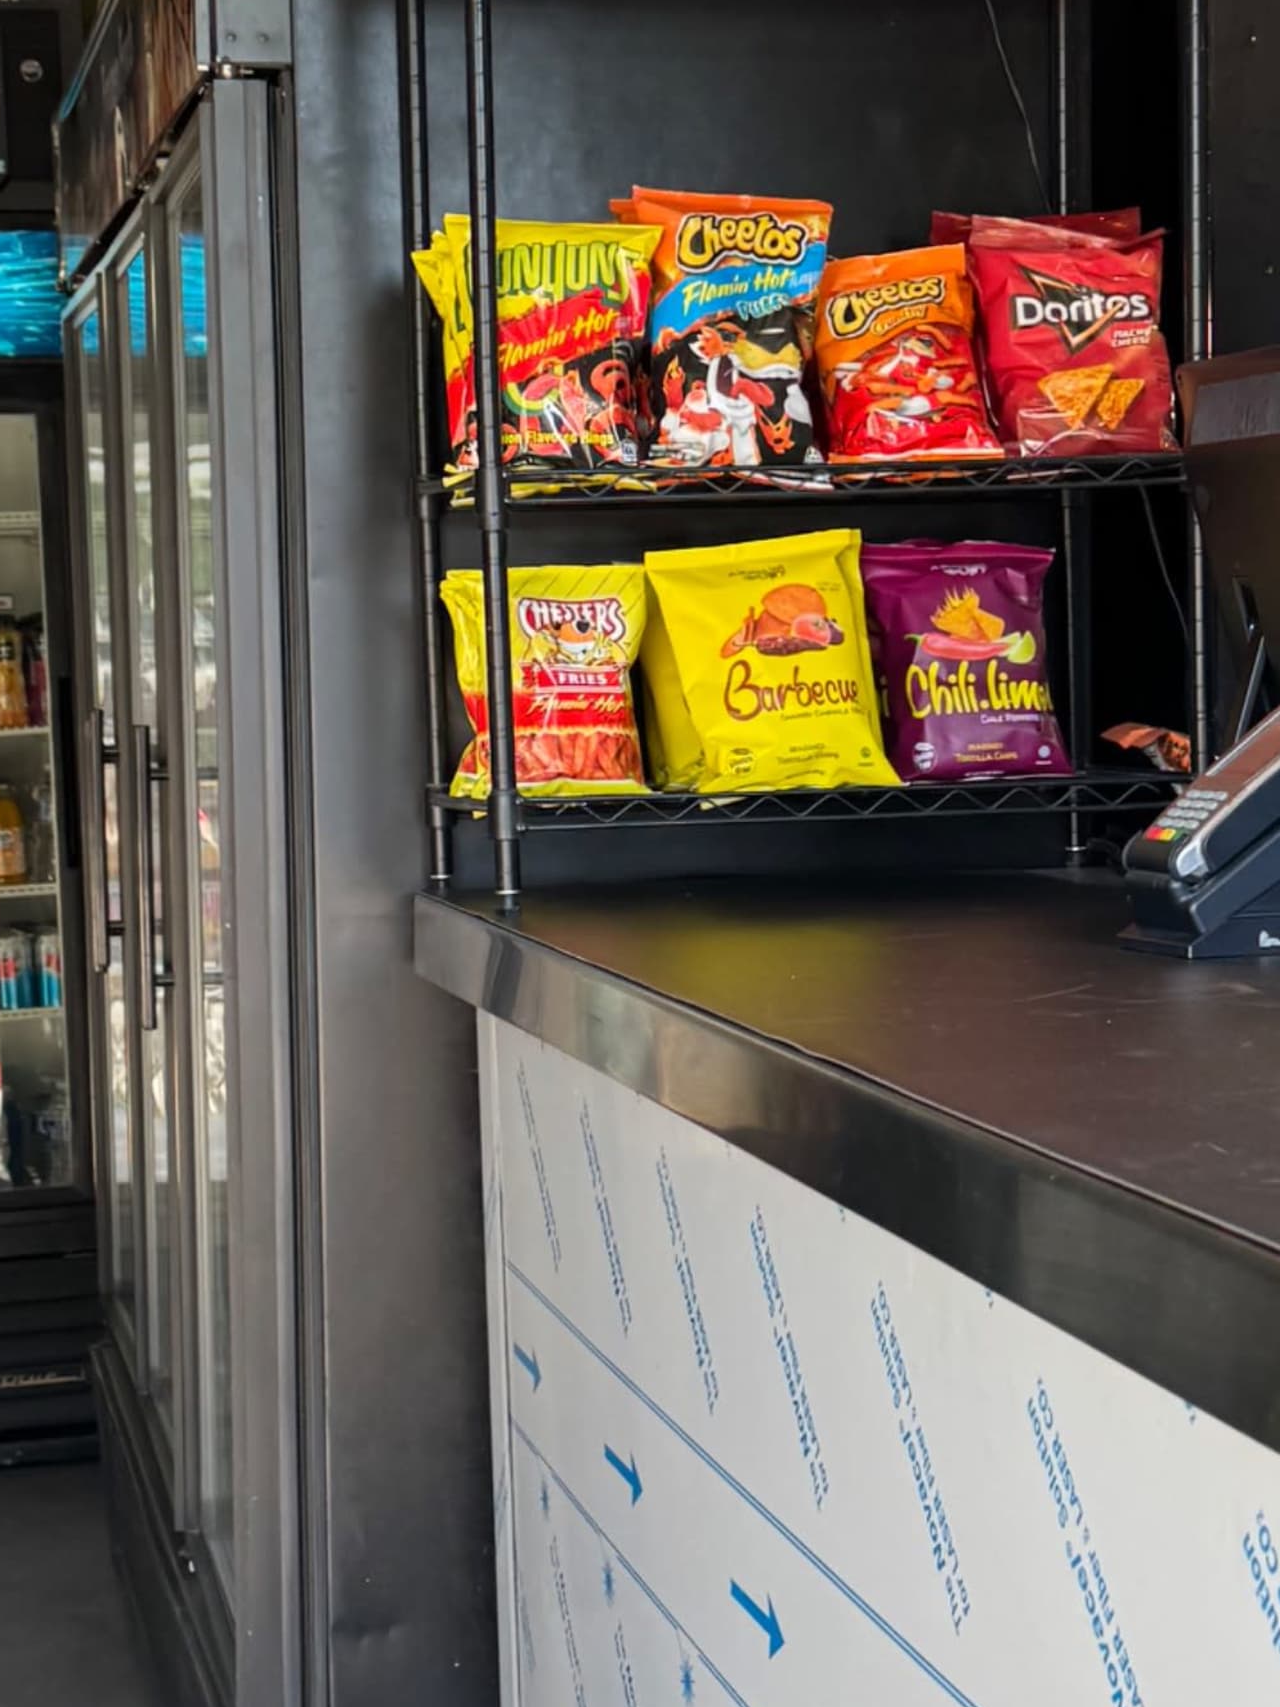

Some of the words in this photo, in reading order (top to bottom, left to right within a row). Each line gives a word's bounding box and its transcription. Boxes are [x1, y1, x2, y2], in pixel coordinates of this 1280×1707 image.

[678, 214, 804, 270] Cheetos
[753, 265, 793, 292] Hot
[573, 307, 620, 339] Hot
[829, 277, 943, 337] Cheetos
[1014, 293, 1150, 328] Doritos
[519, 597, 627, 643] CHESTER'S
[559, 671, 608, 686] FRIES
[724, 659, 859, 722] Barbecue
[1025, 1397, 1070, 1530] Solution
[1050, 1430, 1085, 1527] LASER
[1085, 1550, 1116, 1626] Fiber
